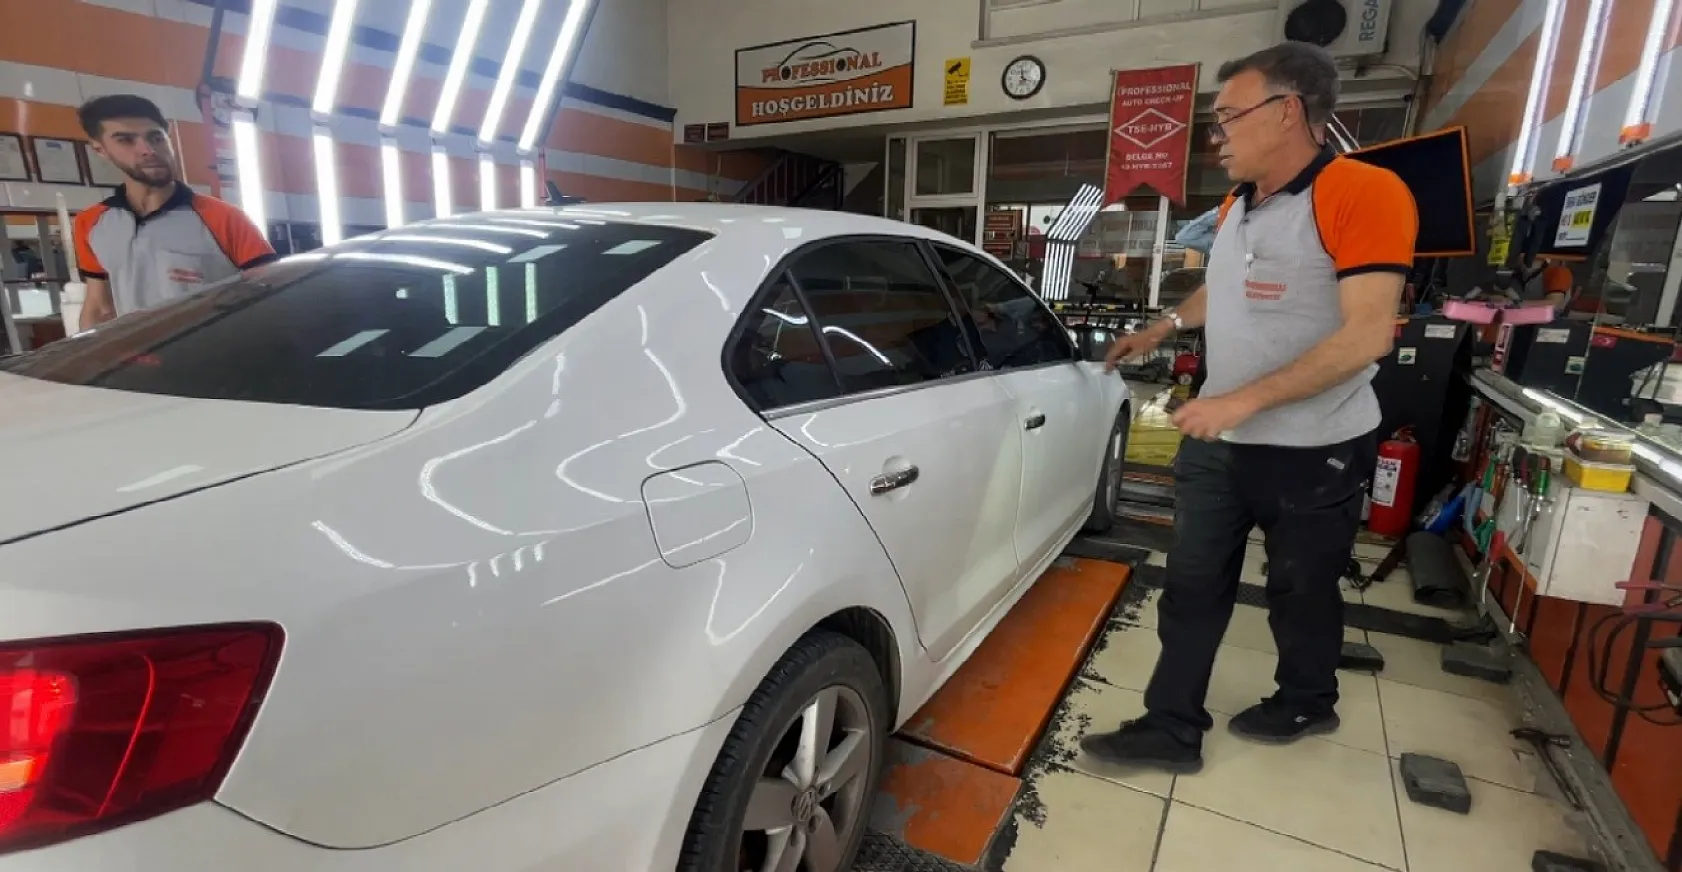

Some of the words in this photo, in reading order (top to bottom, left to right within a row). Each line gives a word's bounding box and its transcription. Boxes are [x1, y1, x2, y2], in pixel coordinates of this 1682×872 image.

[761, 52, 882, 83] PROFESSIONAL
[752, 82, 893, 116] HOŞGELDİNİZ
[1120, 82, 1191, 96] PROFESSIONAL
